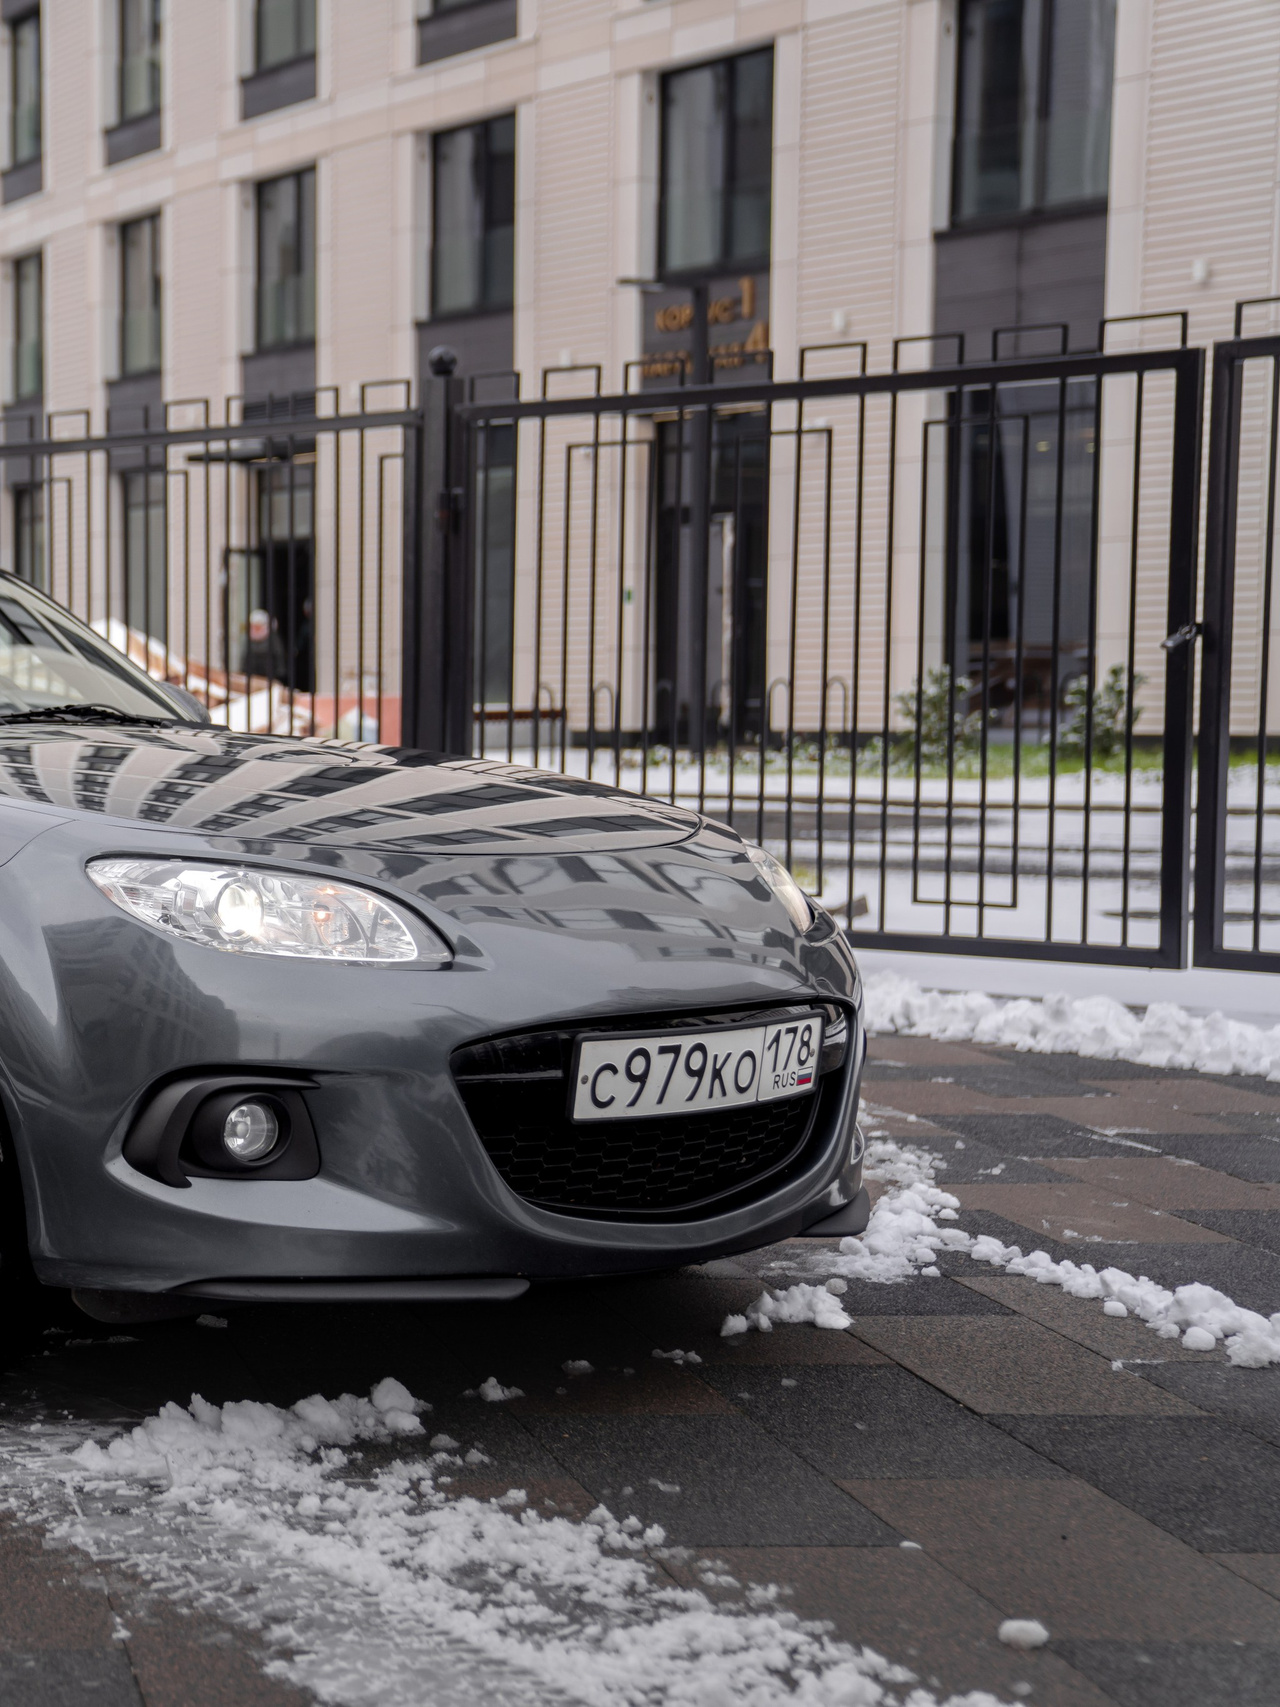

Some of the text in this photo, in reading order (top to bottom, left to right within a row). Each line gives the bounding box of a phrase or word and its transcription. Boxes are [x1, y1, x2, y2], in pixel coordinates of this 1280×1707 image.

[738, 275, 756, 319] 1
[590, 1023, 813, 1109] С979КО 178
[772, 1071, 797, 1090] RUS
